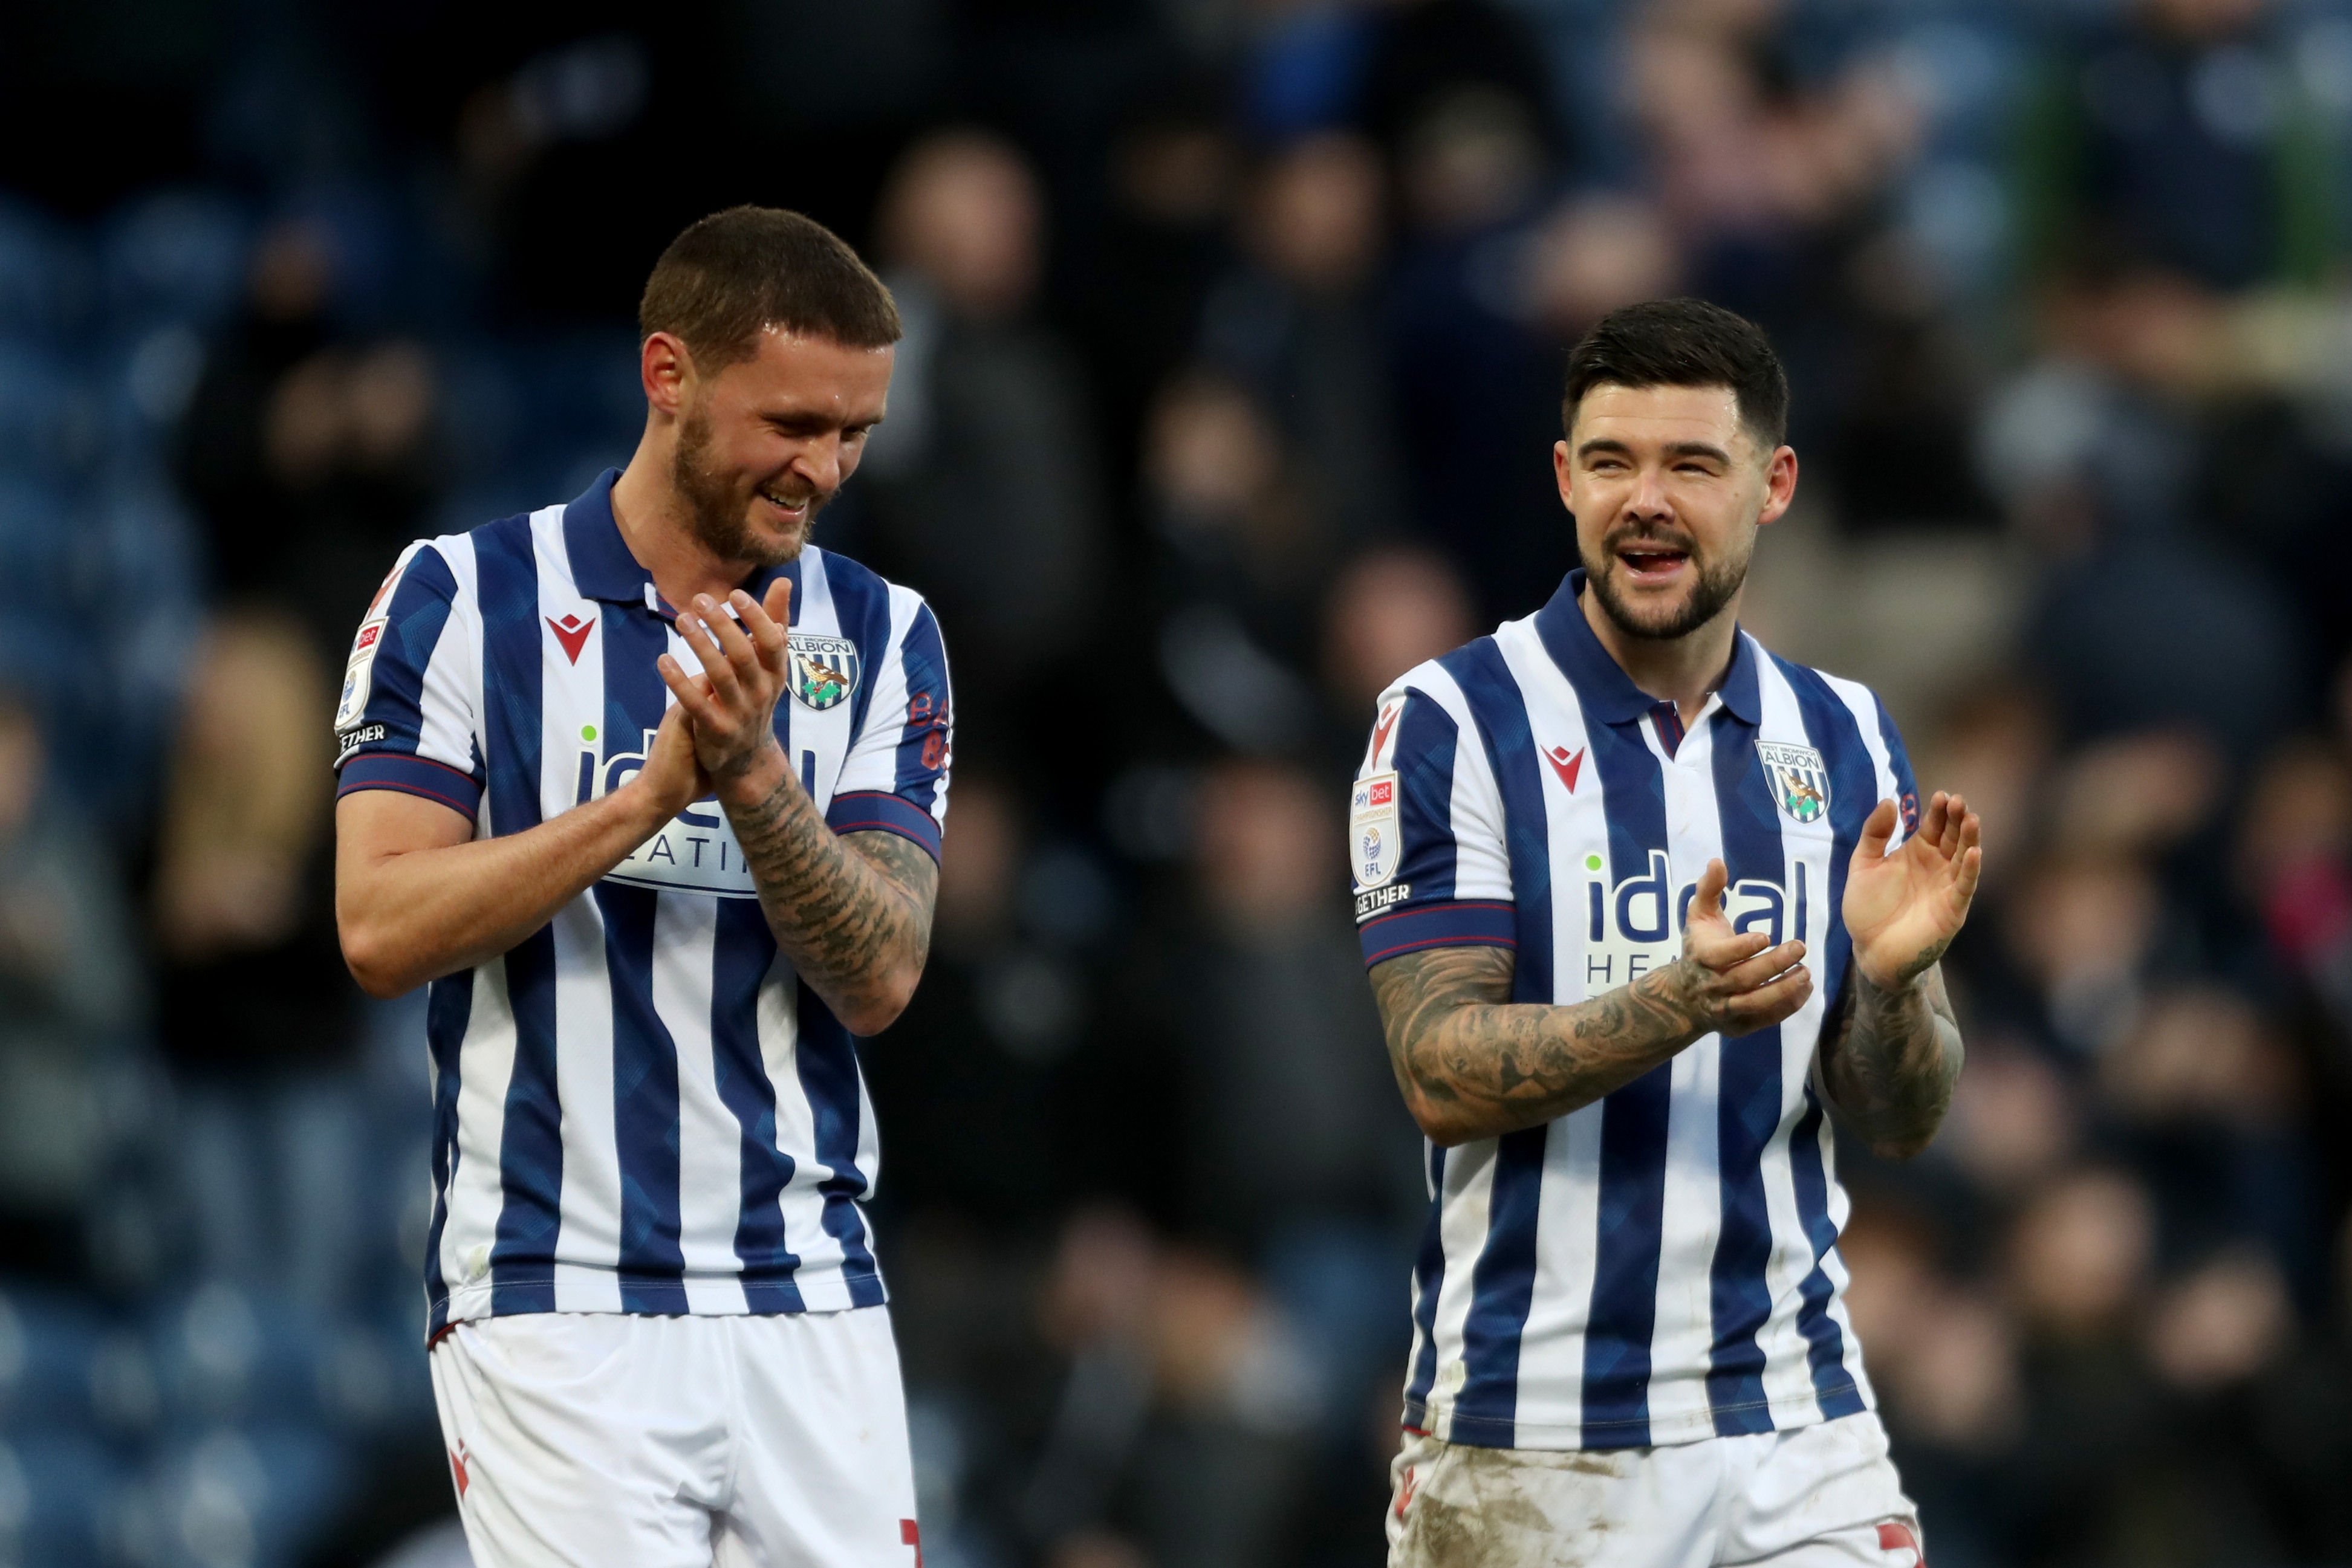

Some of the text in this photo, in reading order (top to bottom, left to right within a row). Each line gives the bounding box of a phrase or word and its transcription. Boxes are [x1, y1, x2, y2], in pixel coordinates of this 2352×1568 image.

[339, 724, 384, 754] ETHER
[1765, 751, 1820, 770] ALBION
[1354, 785, 1390, 807] sky bet
[1365, 862, 1382, 876] EFL
[1355, 884, 1410, 915] GETHER
[1587, 954, 1678, 983] HE
